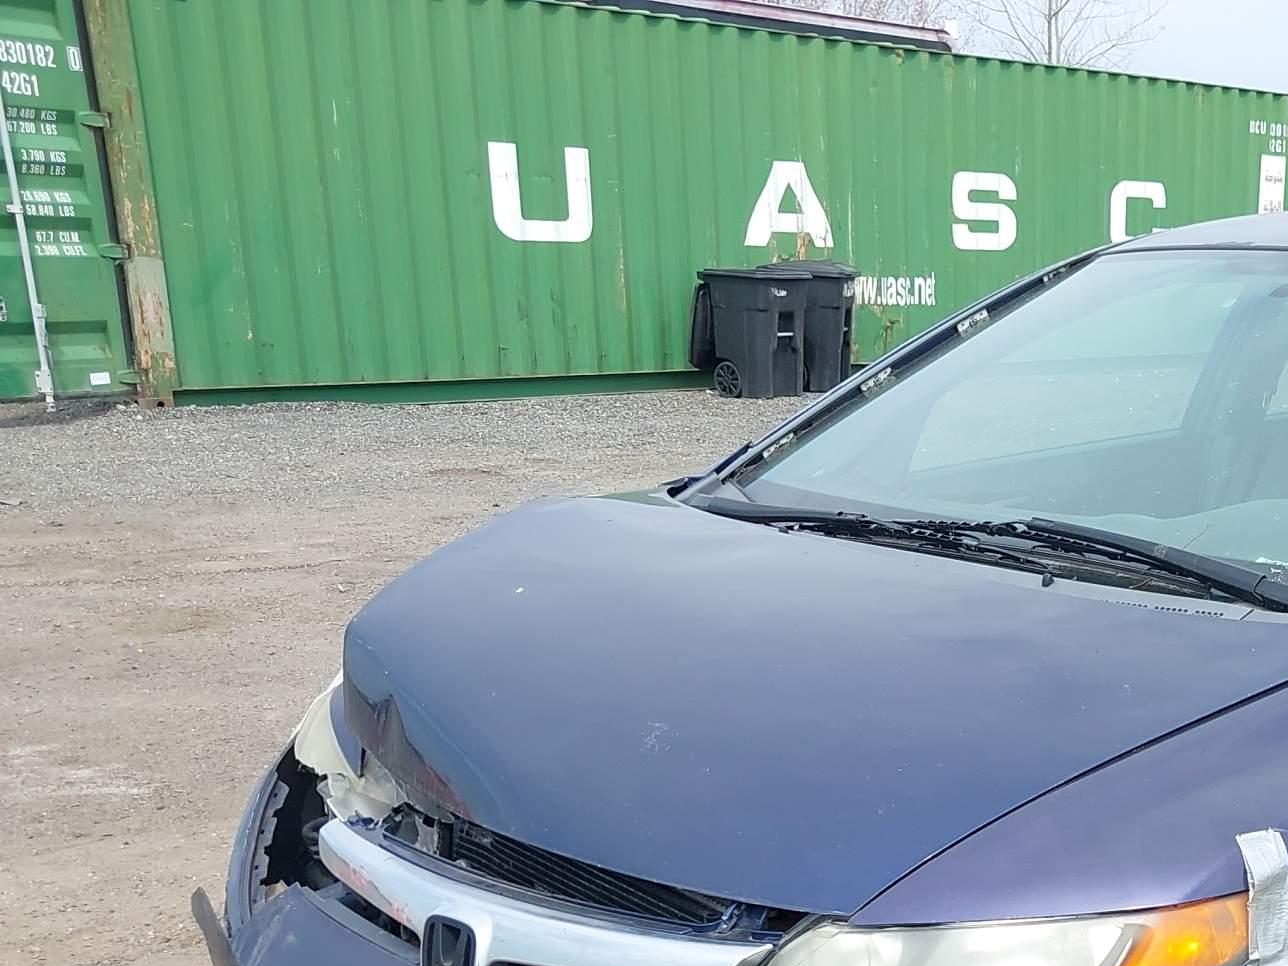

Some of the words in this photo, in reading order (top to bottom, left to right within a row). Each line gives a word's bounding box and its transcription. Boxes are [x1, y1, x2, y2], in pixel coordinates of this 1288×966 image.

[67, 47, 82, 71] 0
[2, 70, 40, 97] 42G1
[41, 110, 57, 121] KGS
[7, 121, 36, 134] 67.200
[41, 123, 58, 136] LBS
[50, 151, 67, 163] KGS
[50, 165, 66, 177] LBS
[53, 191, 72, 203] KGS
[59, 205, 75, 217] LBS
[36, 231, 54, 242] 67.7
[854, 271, 936, 306] ww.uasc.net
